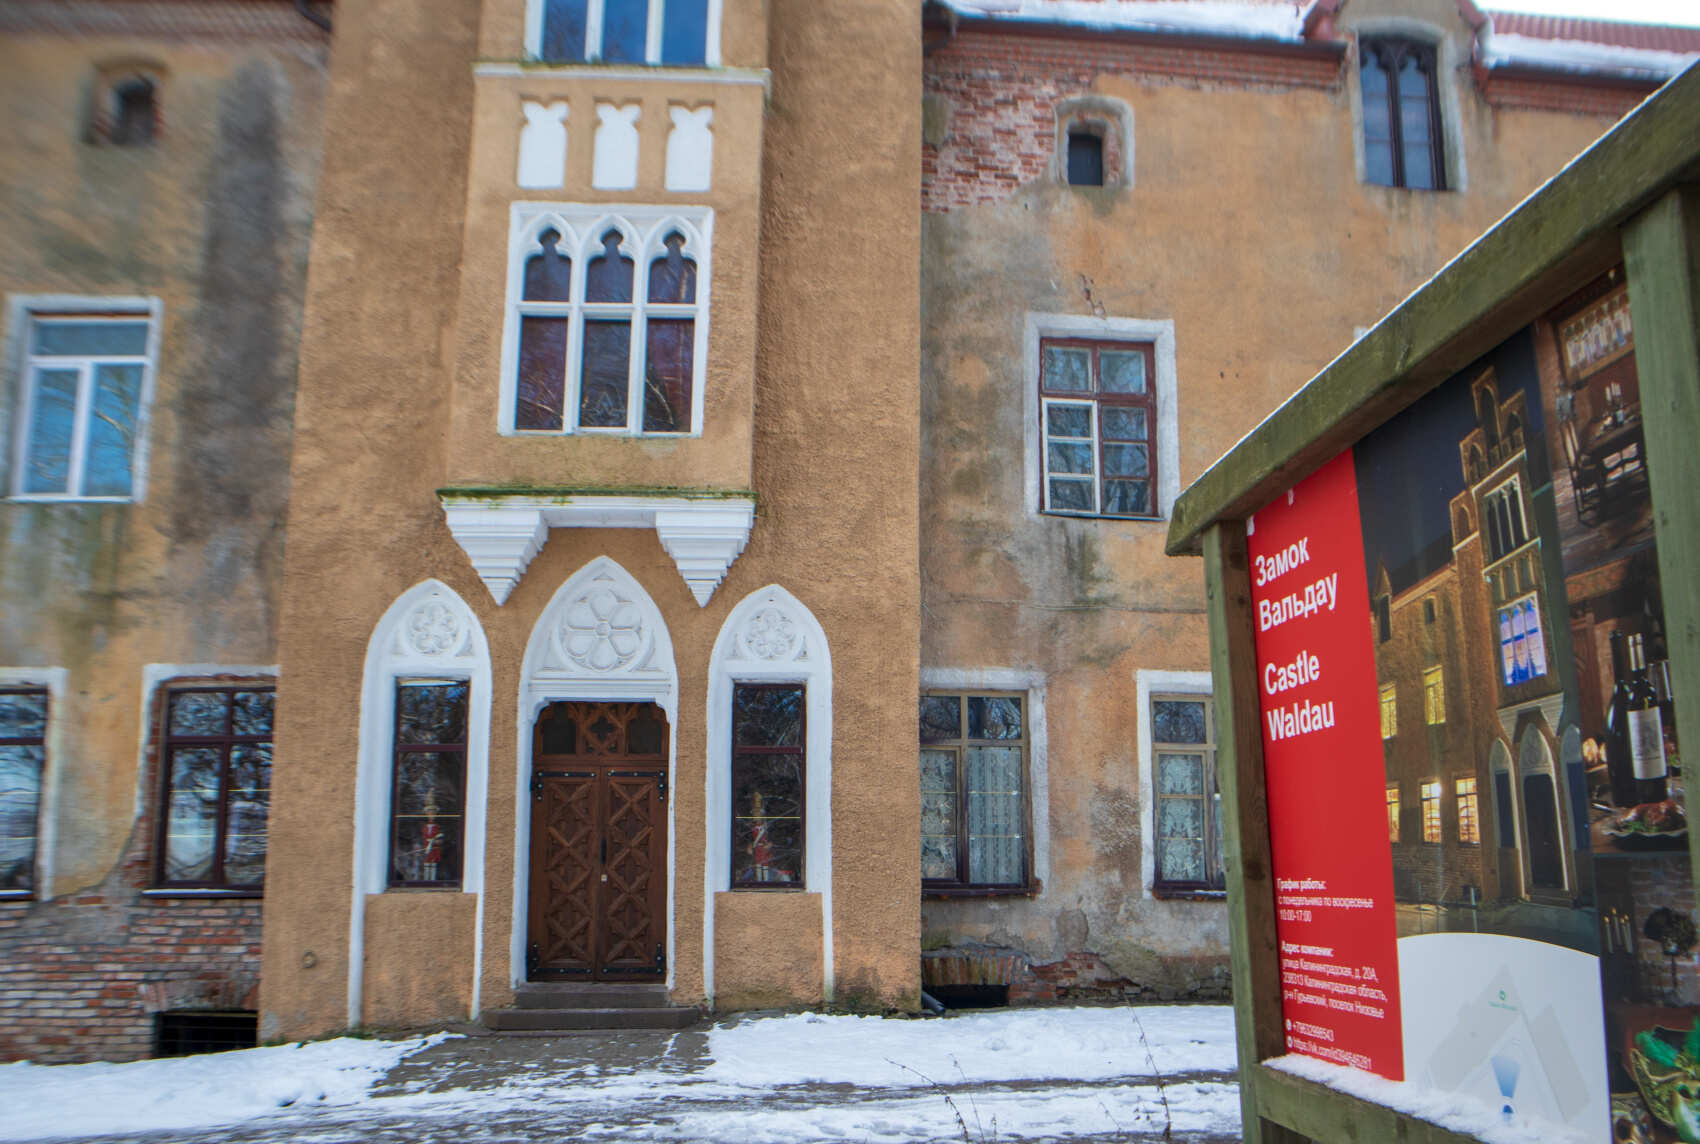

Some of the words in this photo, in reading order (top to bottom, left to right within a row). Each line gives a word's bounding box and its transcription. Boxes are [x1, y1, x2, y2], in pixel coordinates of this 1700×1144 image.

[1255, 537, 1310, 586] Замок
[1259, 573, 1338, 632] Вальдау
[1264, 650, 1320, 695] Castle
[1267, 699, 1335, 741] Waldau
